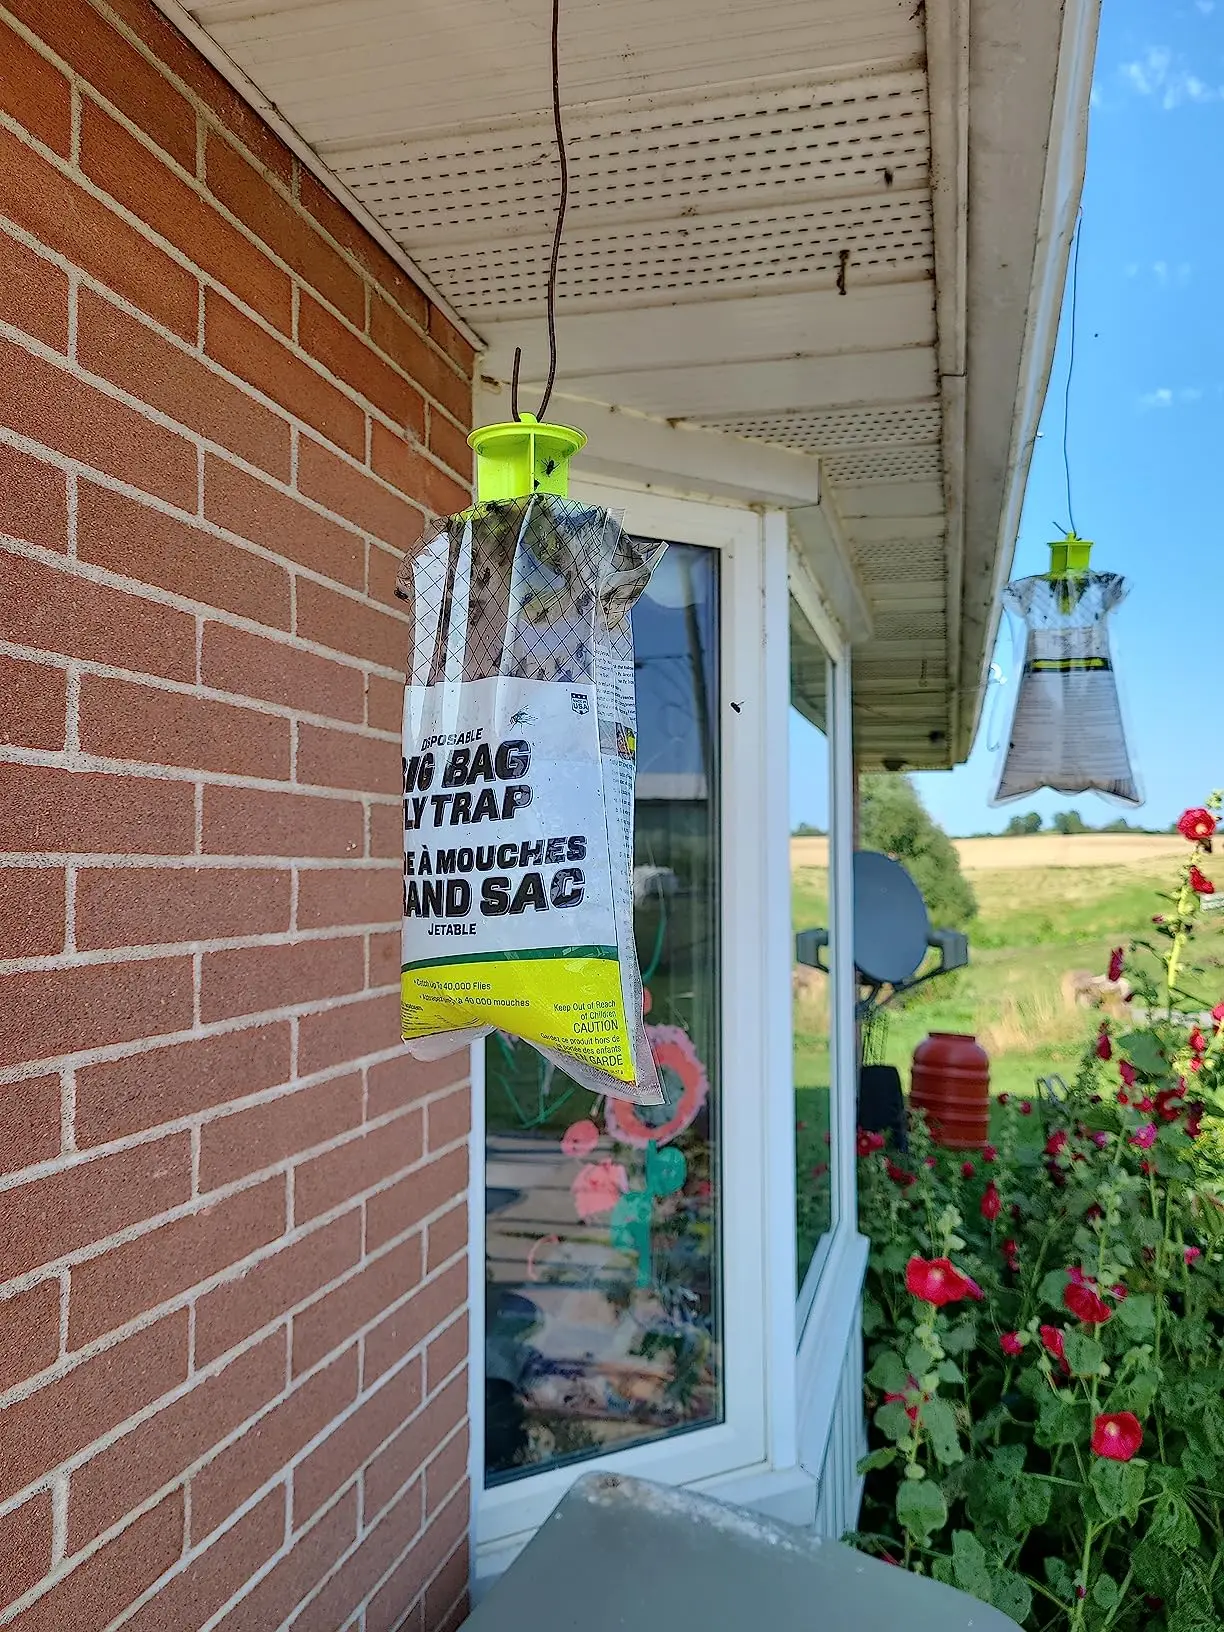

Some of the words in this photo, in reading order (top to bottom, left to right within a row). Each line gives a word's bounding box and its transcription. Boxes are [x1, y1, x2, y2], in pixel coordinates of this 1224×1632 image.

[402, 753, 436, 793] IG
[441, 740, 532, 789] BAG
[404, 851, 415, 875] E
[418, 844, 432, 876] À
[436, 835, 588, 875] MOUCHES
[480, 868, 585, 918] SAC
[427, 923, 477, 936] JETABLE
[443, 982, 471, 991] 40,000
[473, 982, 492, 990] Flies
[494, 997, 530, 1007] mouches
[553, 1003, 571, 1013] Keep
[572, 1002, 586, 1011] Out
[587, 1002, 594, 1010] of
[595, 1000, 616, 1009] Reach
[580, 1012, 588, 1021] of
[589, 1010, 617, 1020] Children
[573, 1019, 619, 1034] CAUTION
[594, 1036, 611, 1044] hors
[612, 1034, 621, 1043] de
[582, 1046, 595, 1054] des
[596, 1045, 621, 1055] enfants
[589, 1054, 624, 1067] GARDE
